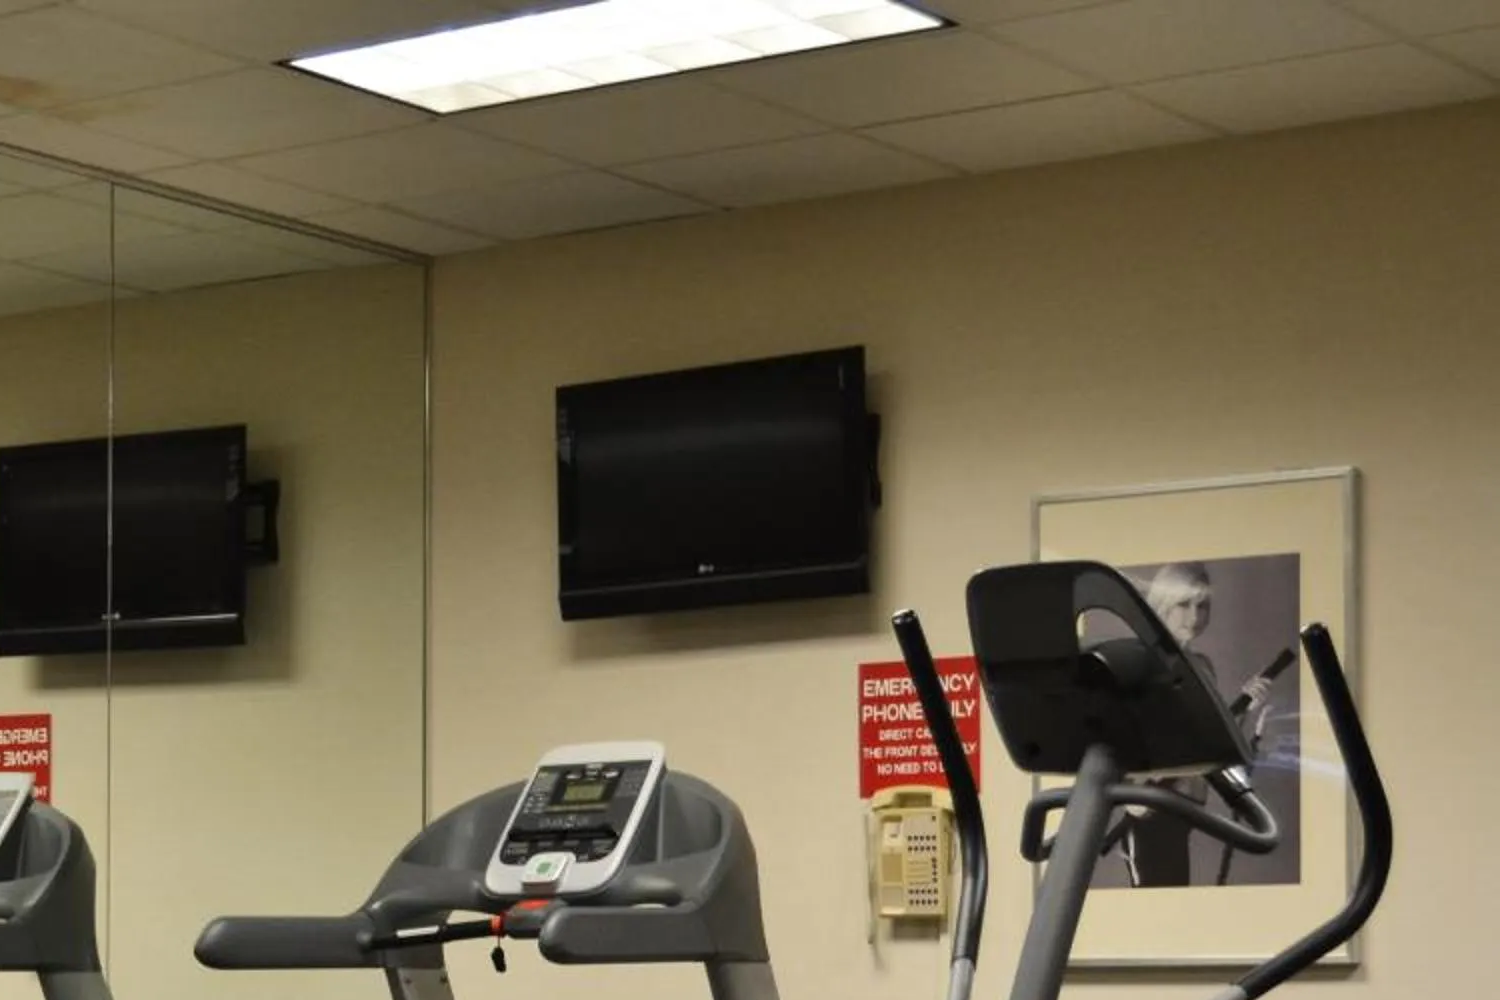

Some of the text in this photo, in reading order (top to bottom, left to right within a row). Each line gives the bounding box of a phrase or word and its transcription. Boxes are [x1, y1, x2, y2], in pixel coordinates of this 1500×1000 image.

[863, 674, 975, 697] EMERNCY
[862, 702, 924, 723] PHONE
[878, 728, 914, 741] DIRECT
[863, 747, 883, 759] THE
[884, 745, 918, 758] FRONT
[920, 743, 939, 757] DES
[877, 763, 893, 775] NO
[894, 761, 920, 775] NEED
[922, 760, 937, 773] TO
